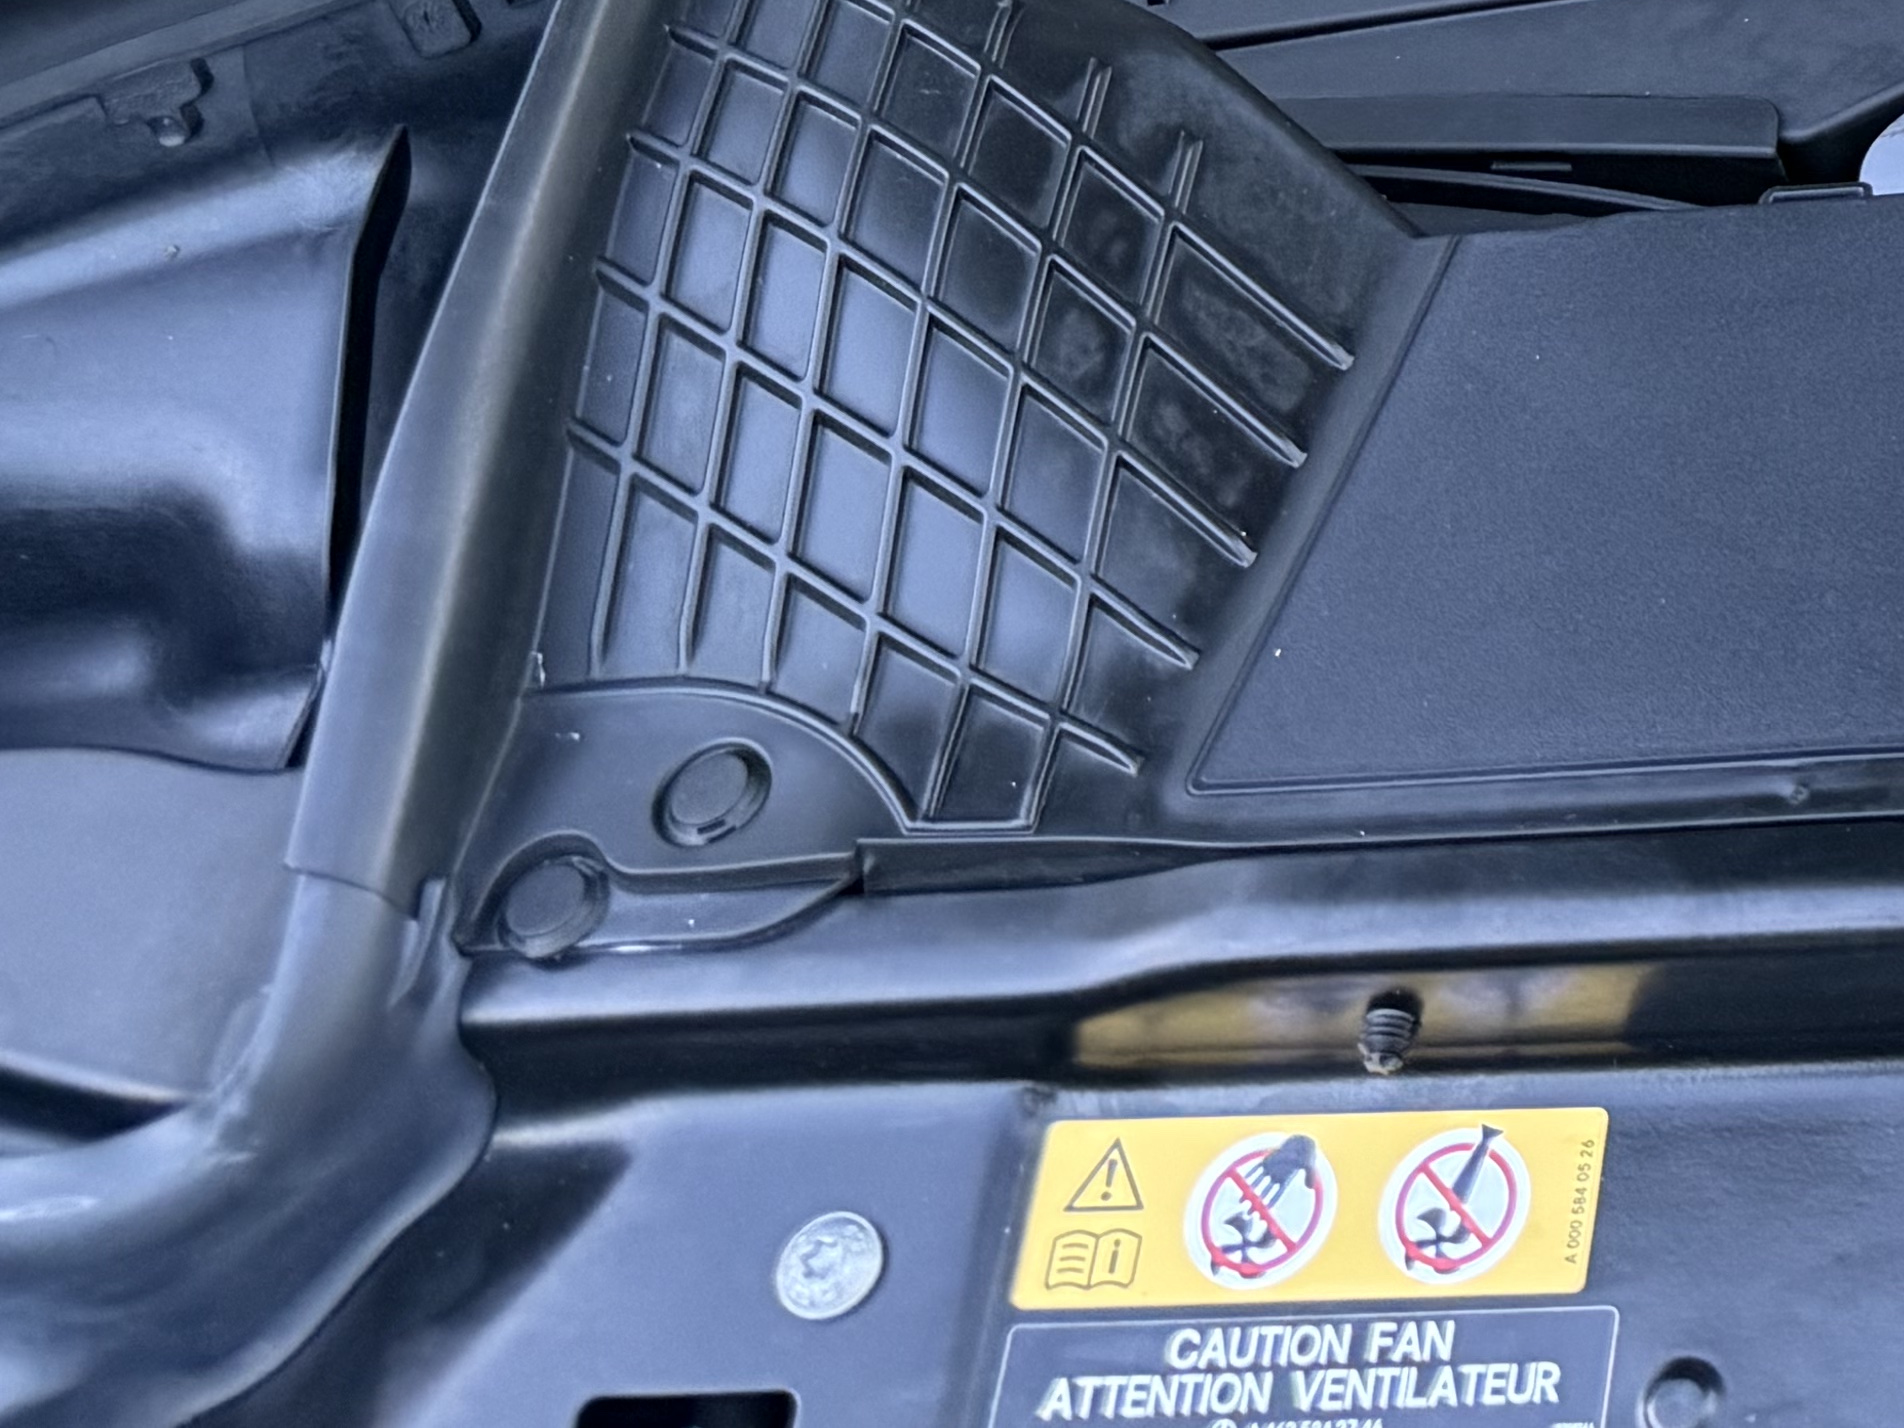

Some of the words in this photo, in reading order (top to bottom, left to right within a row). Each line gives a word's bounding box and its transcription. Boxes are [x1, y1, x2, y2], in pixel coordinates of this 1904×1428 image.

[1580, 1139, 1596, 1159] 26
[1576, 1162, 1591, 1183] 05
[1571, 1186, 1588, 1215] 584
[1566, 1219, 1583, 1250] 000
[1564, 1253, 1578, 1265] A
[1164, 1323, 1352, 1370] CAUTION
[1364, 1319, 1456, 1365] FAN
[1035, 1370, 1274, 1422] ATTENTION
[1290, 1360, 1562, 1413] VENTILATEUR
